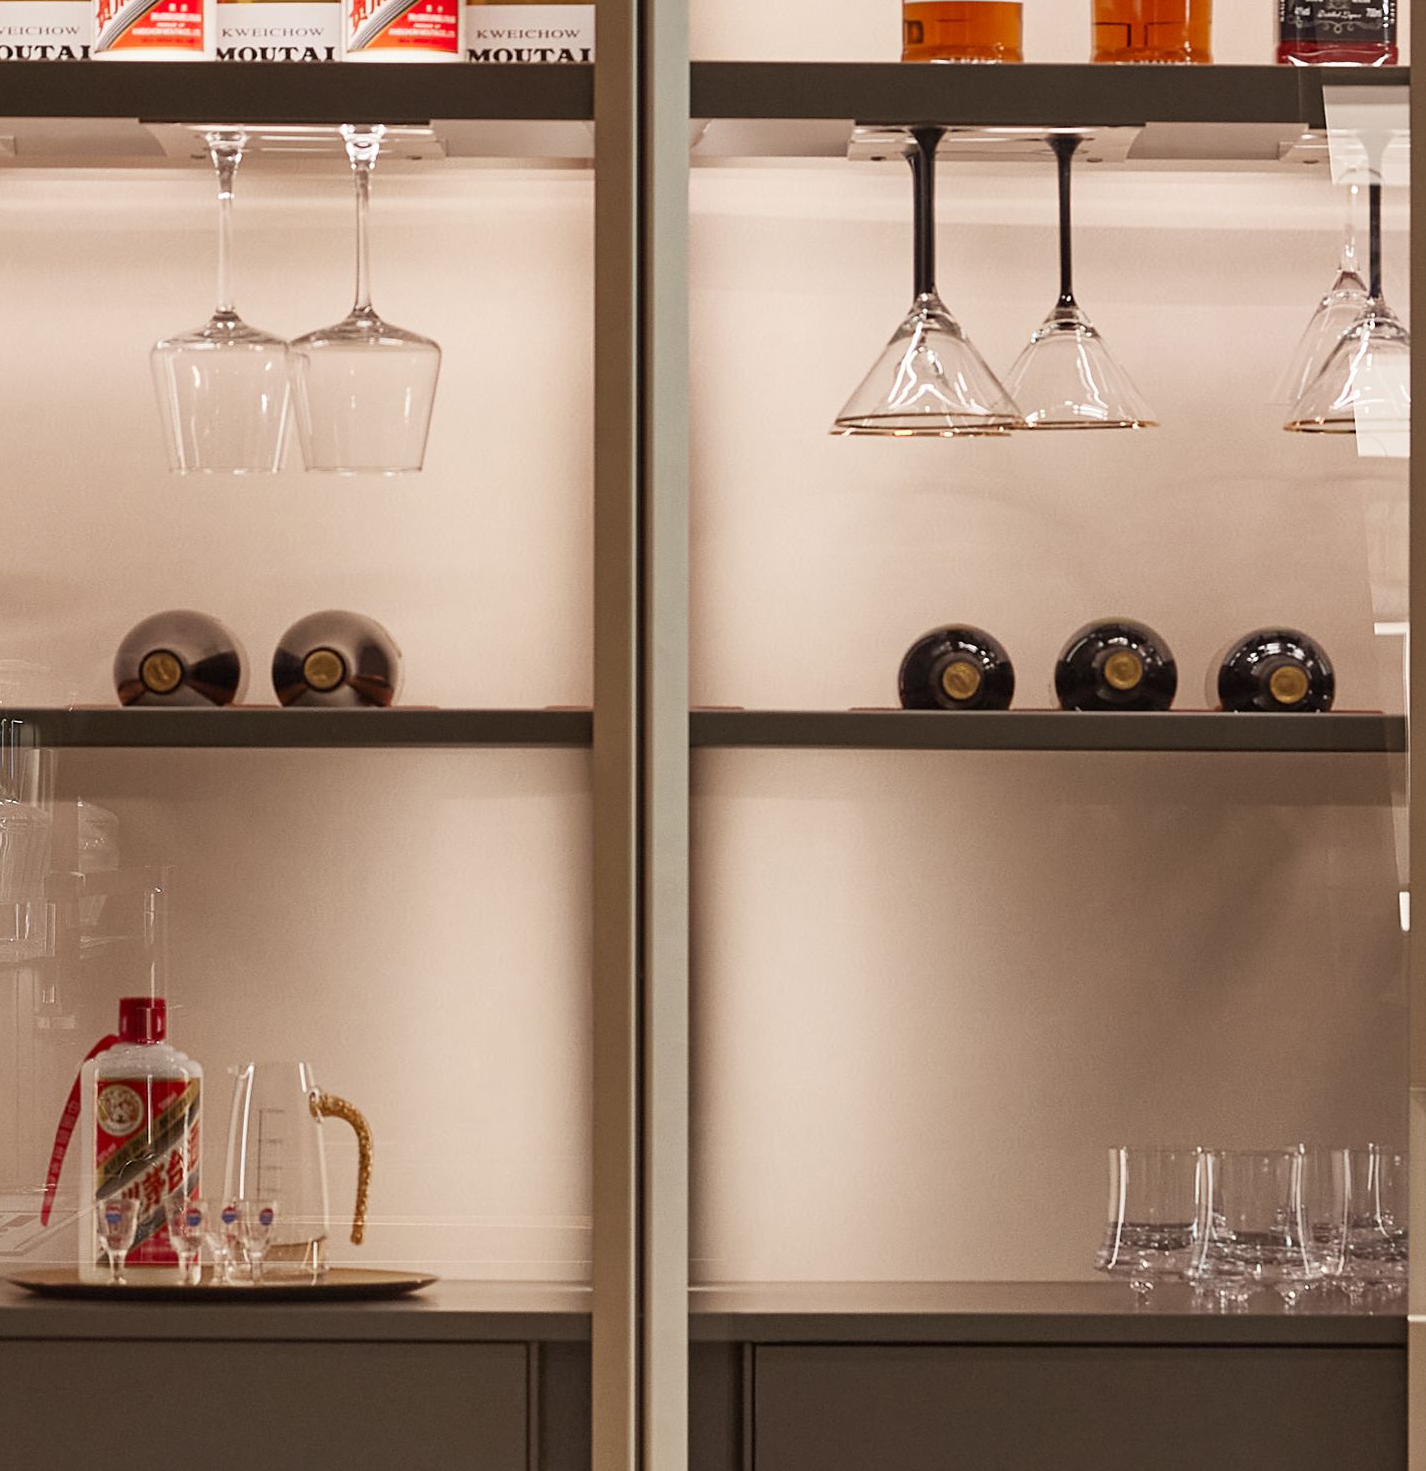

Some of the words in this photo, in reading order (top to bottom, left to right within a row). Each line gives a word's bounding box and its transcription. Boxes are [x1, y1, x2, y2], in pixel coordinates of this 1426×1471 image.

[221, 28, 325, 38] KWEICHOW
[476, 29, 581, 39] KWEICHOW
[215, 46, 336, 62] MOUTAI
[467, 48, 592, 63] MOUTAI
